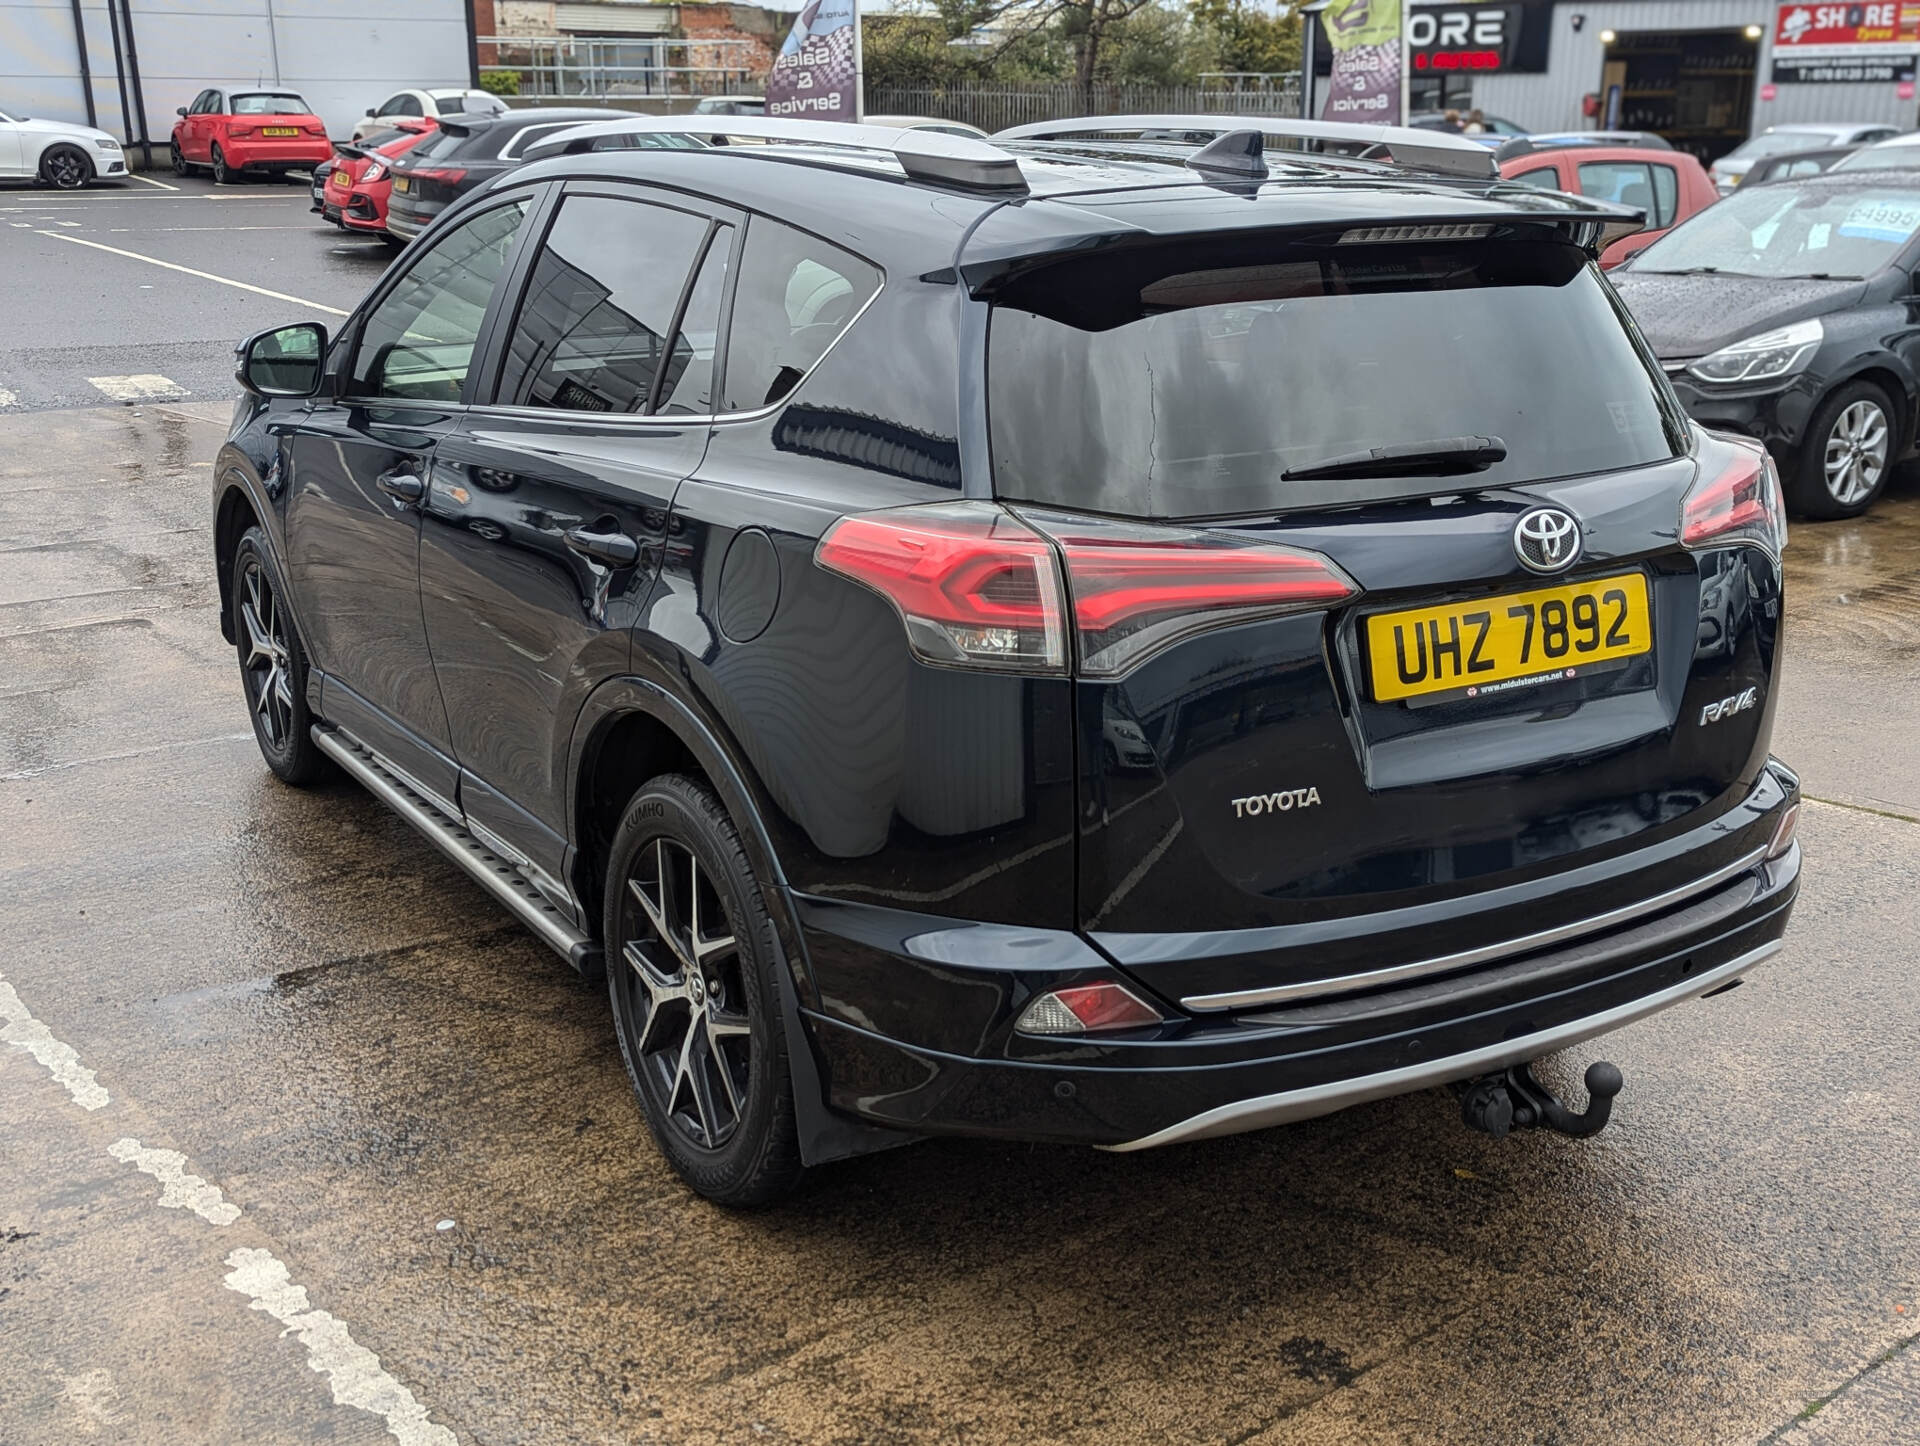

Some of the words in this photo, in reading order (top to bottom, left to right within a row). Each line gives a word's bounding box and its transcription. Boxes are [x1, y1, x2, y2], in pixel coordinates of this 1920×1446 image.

[1393, 611, 1496, 685] UHZ
[1507, 589, 1631, 665] 7892
[1480, 670, 1563, 694] www.midulstercars.net
[1699, 686, 1757, 727] RAV4
[624, 802, 664, 832] KUMHO
[1231, 787, 1321, 818] TOYOTA
